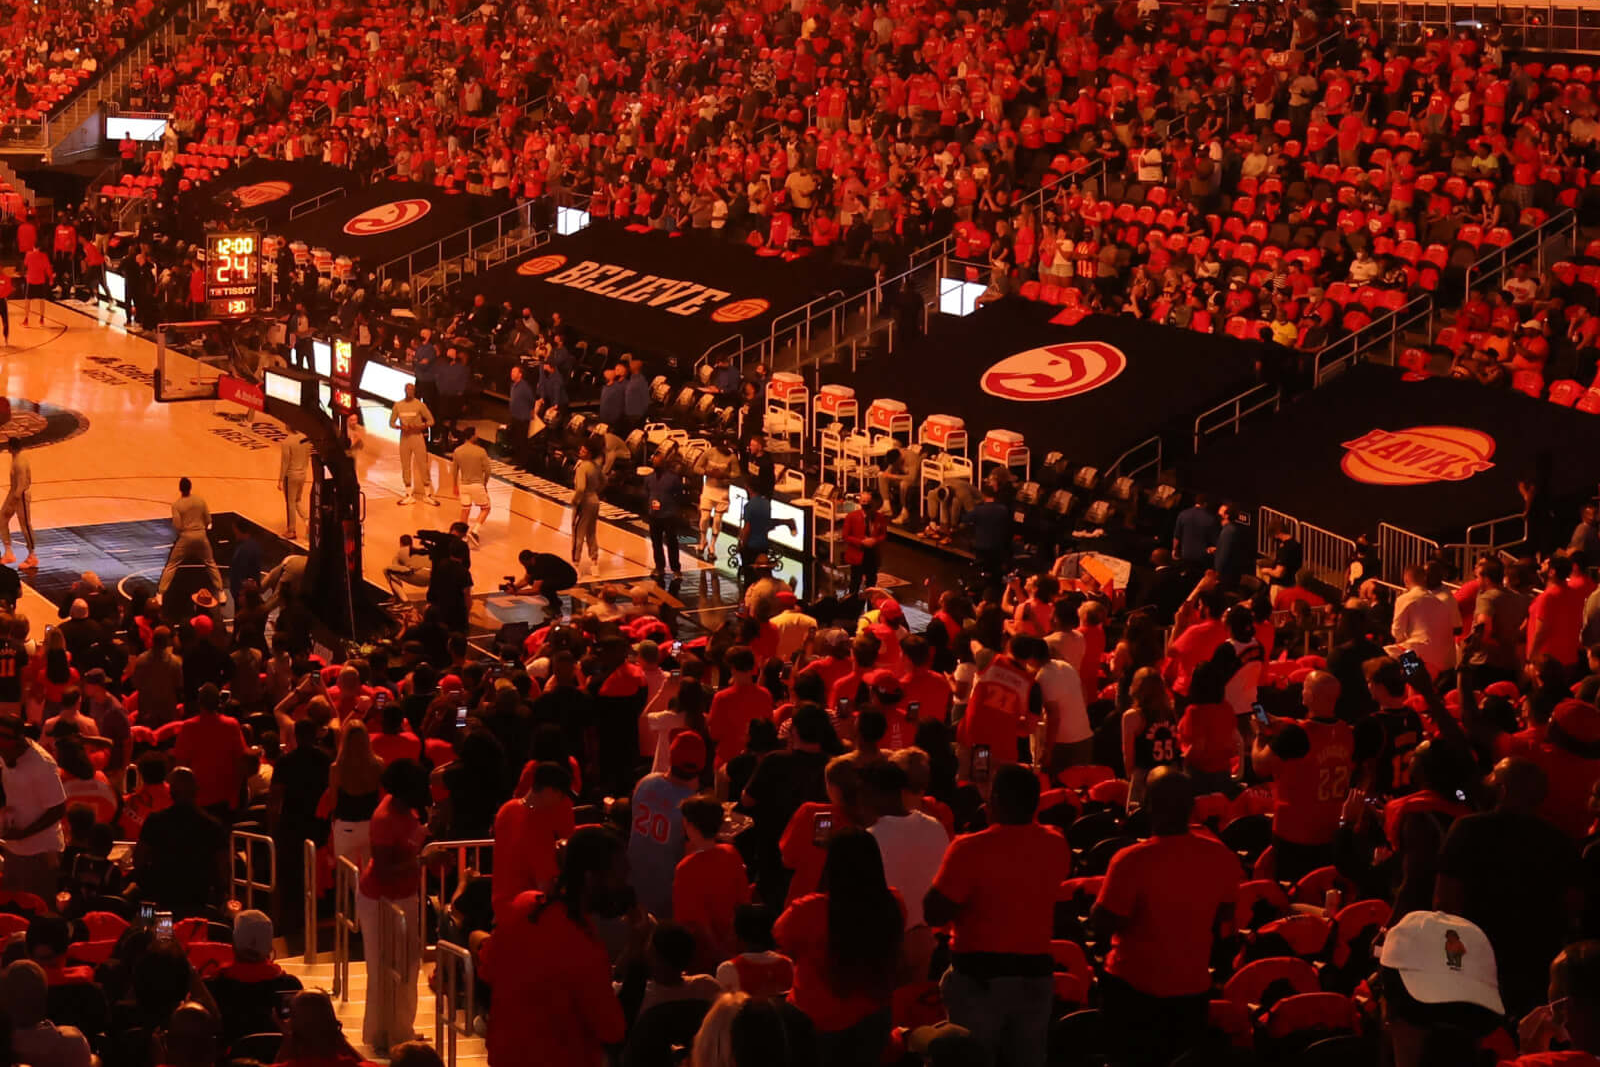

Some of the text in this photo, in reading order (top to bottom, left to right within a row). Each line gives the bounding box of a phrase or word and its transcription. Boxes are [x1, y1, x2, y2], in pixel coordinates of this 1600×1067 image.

[217, 237, 253, 255] 12:00
[216, 255, 249, 282] 24
[223, 286, 257, 295] TISSOT
[544, 260, 732, 316] BELIEVE
[826, 395, 834, 406] G
[877, 410, 886, 421] G
[933, 425, 942, 436] G
[991, 442, 1001, 453] G
[1341, 429, 1496, 480] HAWKS
[1316, 765, 1350, 802] 22
[635, 804, 670, 843] 20
